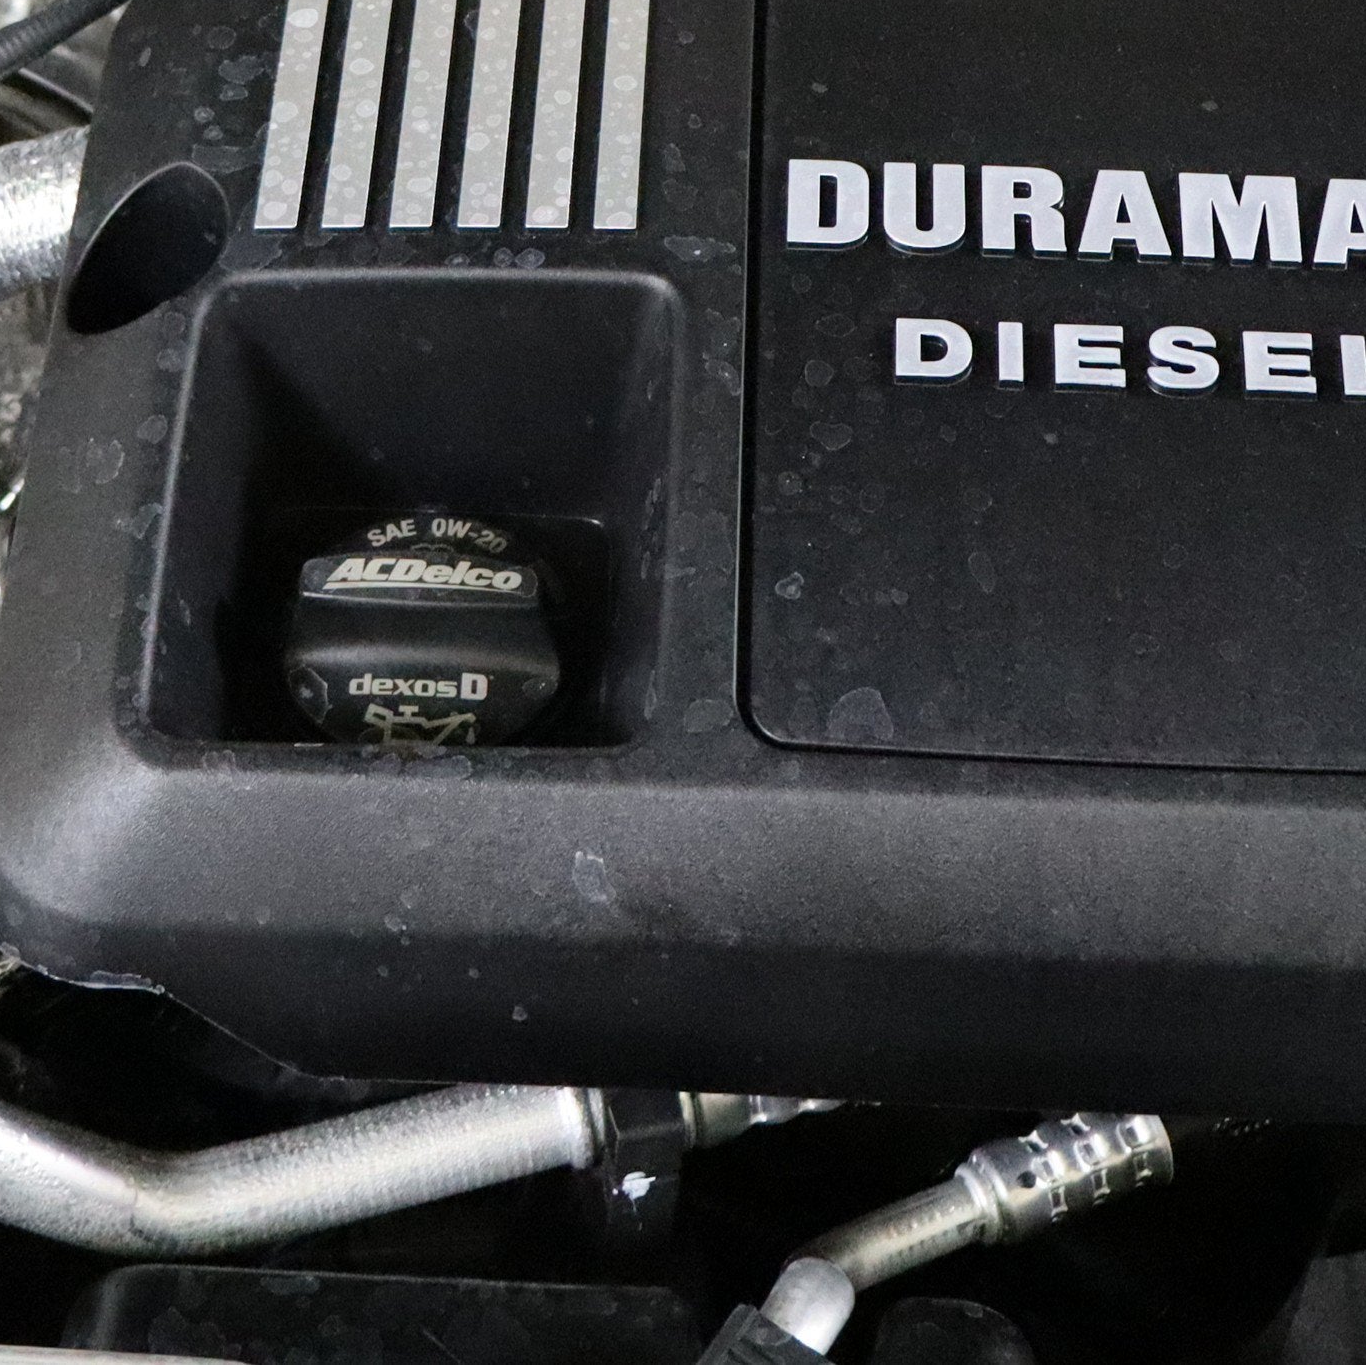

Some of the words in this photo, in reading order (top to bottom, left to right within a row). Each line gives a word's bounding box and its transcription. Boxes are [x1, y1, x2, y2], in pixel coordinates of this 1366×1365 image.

[366, 519, 418, 548] SAE
[431, 517, 509, 554] 0W-20
[323, 557, 523, 591] ACDelco
